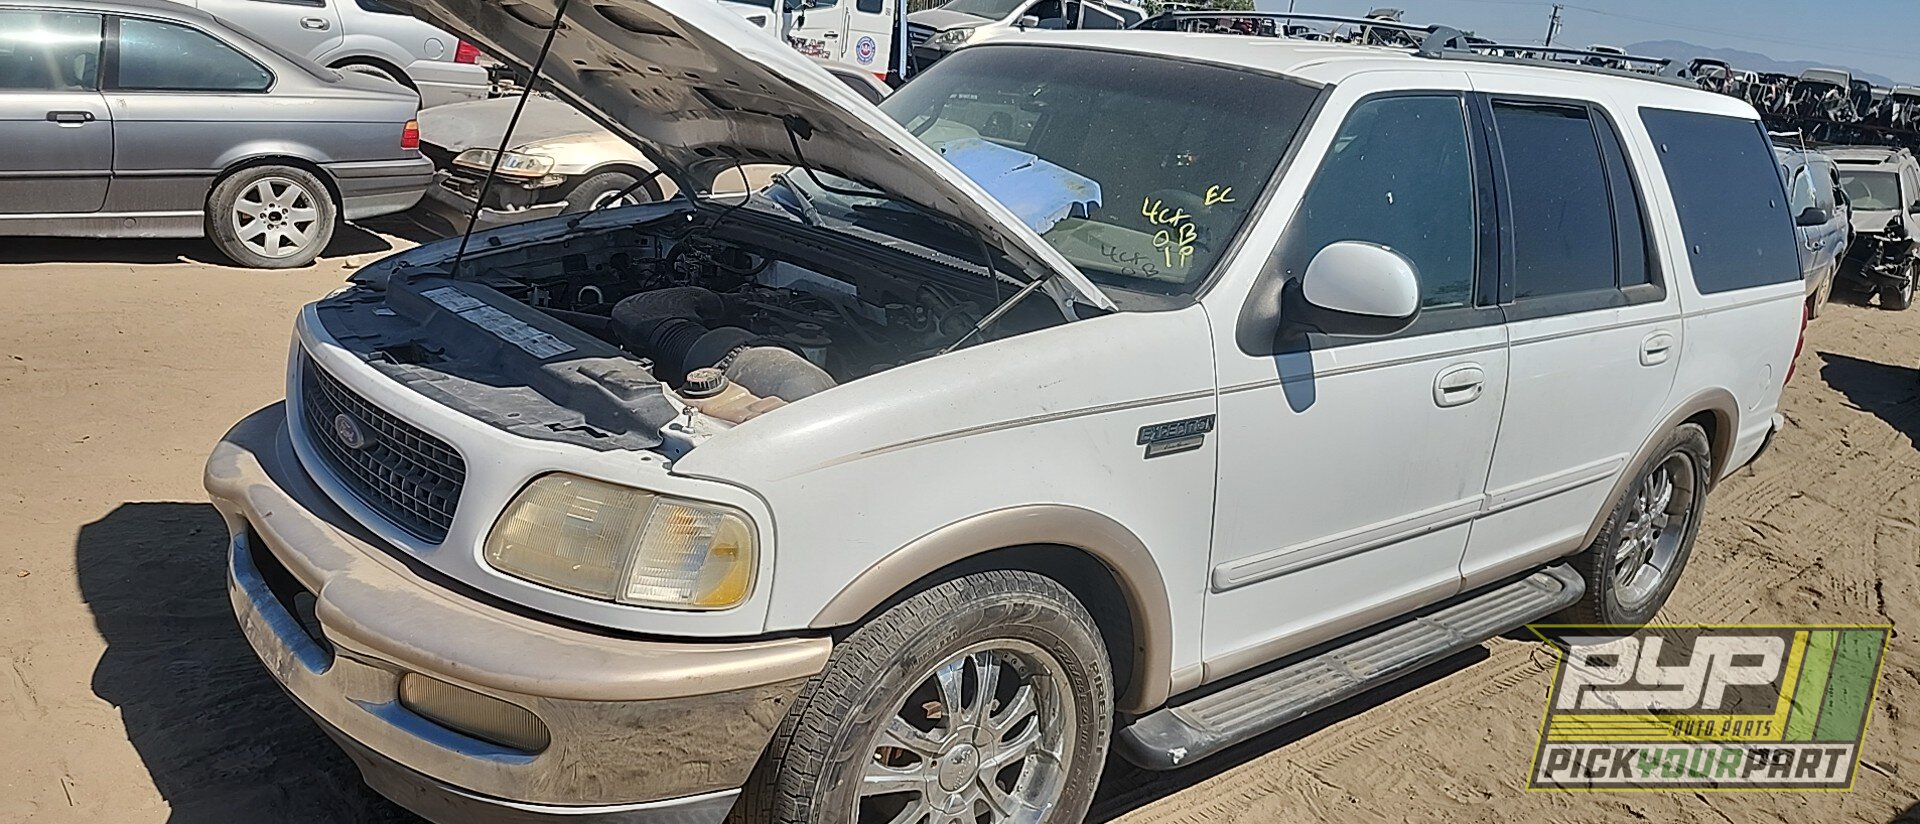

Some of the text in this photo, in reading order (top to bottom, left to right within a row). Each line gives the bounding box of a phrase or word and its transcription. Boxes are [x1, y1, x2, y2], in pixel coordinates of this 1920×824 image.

[1205, 185, 1235, 206] EC
[1141, 417, 1215, 441] EXPEDITION
[1088, 659, 1107, 755] PIRELLI
